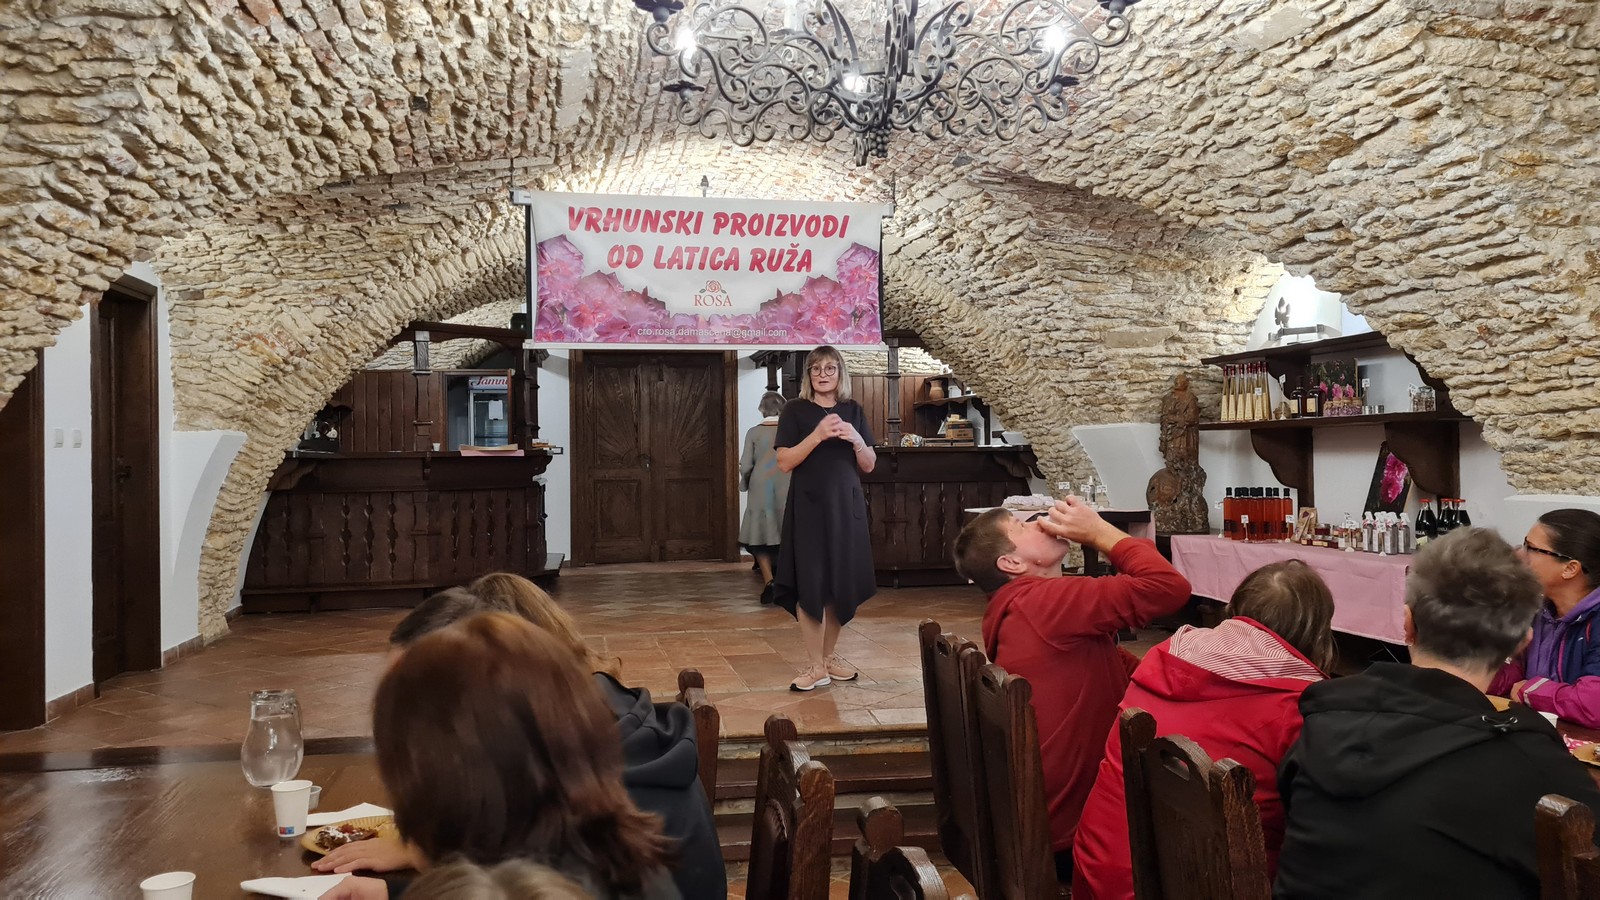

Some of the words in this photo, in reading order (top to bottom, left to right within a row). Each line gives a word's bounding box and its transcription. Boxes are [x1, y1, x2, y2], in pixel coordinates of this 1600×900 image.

[568, 206, 704, 235] VRHUNSKI
[713, 212, 850, 239] PROIZVODI
[607, 245, 644, 270] OD
[653, 246, 740, 272] LATICA
[749, 243, 813, 273] RUŽA
[694, 294, 733, 308] ROSA
[637, 326, 788, 339] cro.rosa.damascena@gmail.com
